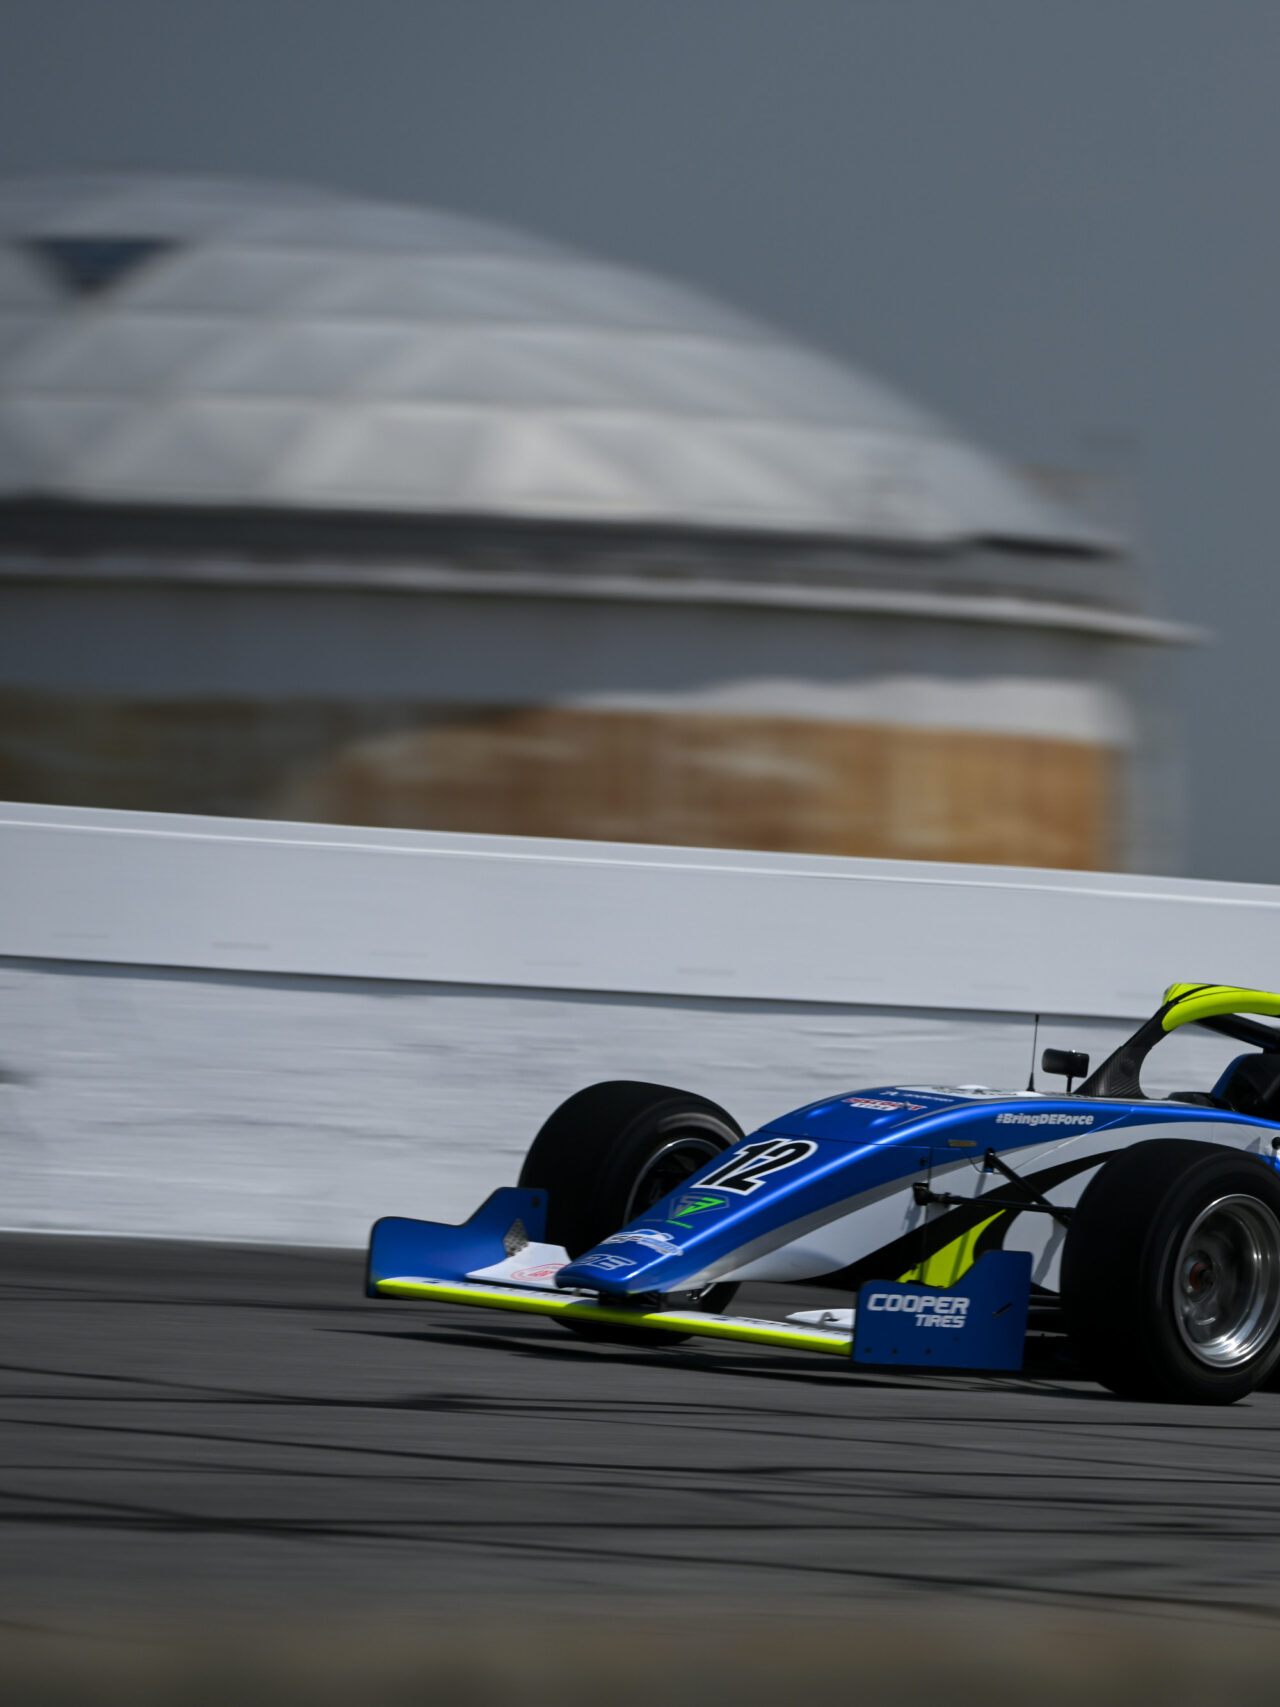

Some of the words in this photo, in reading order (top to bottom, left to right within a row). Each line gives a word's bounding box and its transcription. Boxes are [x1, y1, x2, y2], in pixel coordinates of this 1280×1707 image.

[996, 1113, 1094, 1126] #BringDEForce
[690, 1138, 819, 1196] 12
[867, 1293, 970, 1315] COOPER
[914, 1314, 968, 1328] TIRES
